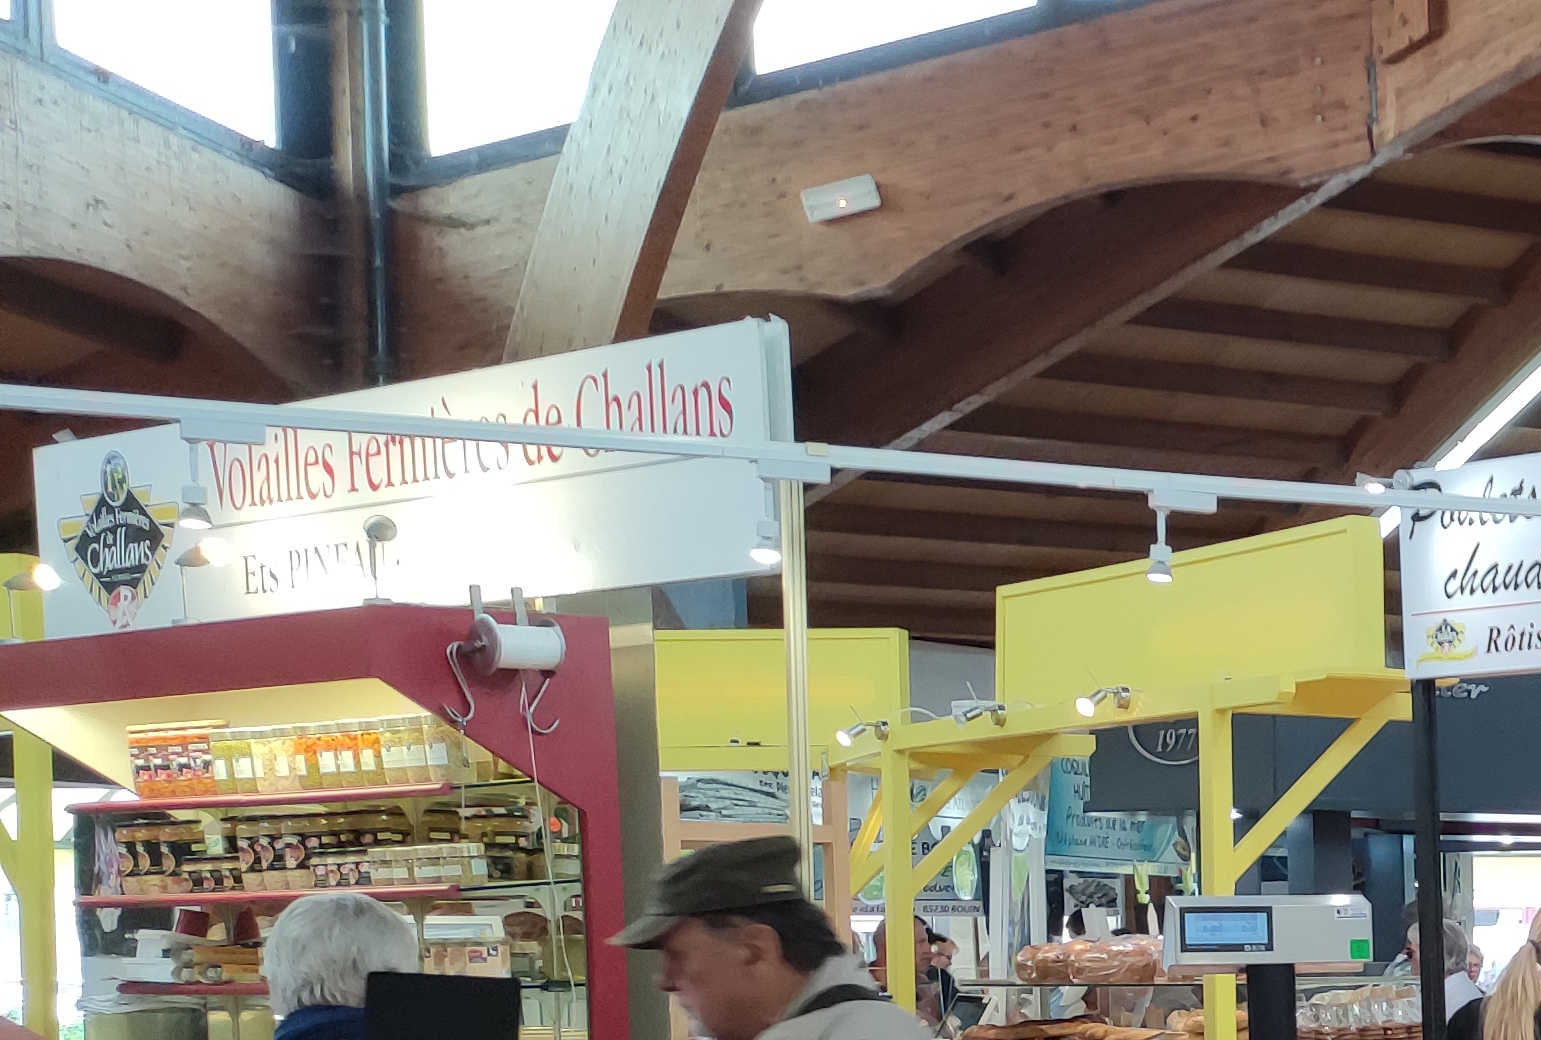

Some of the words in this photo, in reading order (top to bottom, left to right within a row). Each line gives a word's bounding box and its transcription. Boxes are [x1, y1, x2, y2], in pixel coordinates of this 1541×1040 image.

[207, 426, 336, 511] Volailles
[522, 378, 564, 467] de
[575, 357, 736, 457] Challans
[87, 526, 151, 575] Challans
[243, 555, 279, 595] Ets
[1157, 728, 1197, 752] 1977
